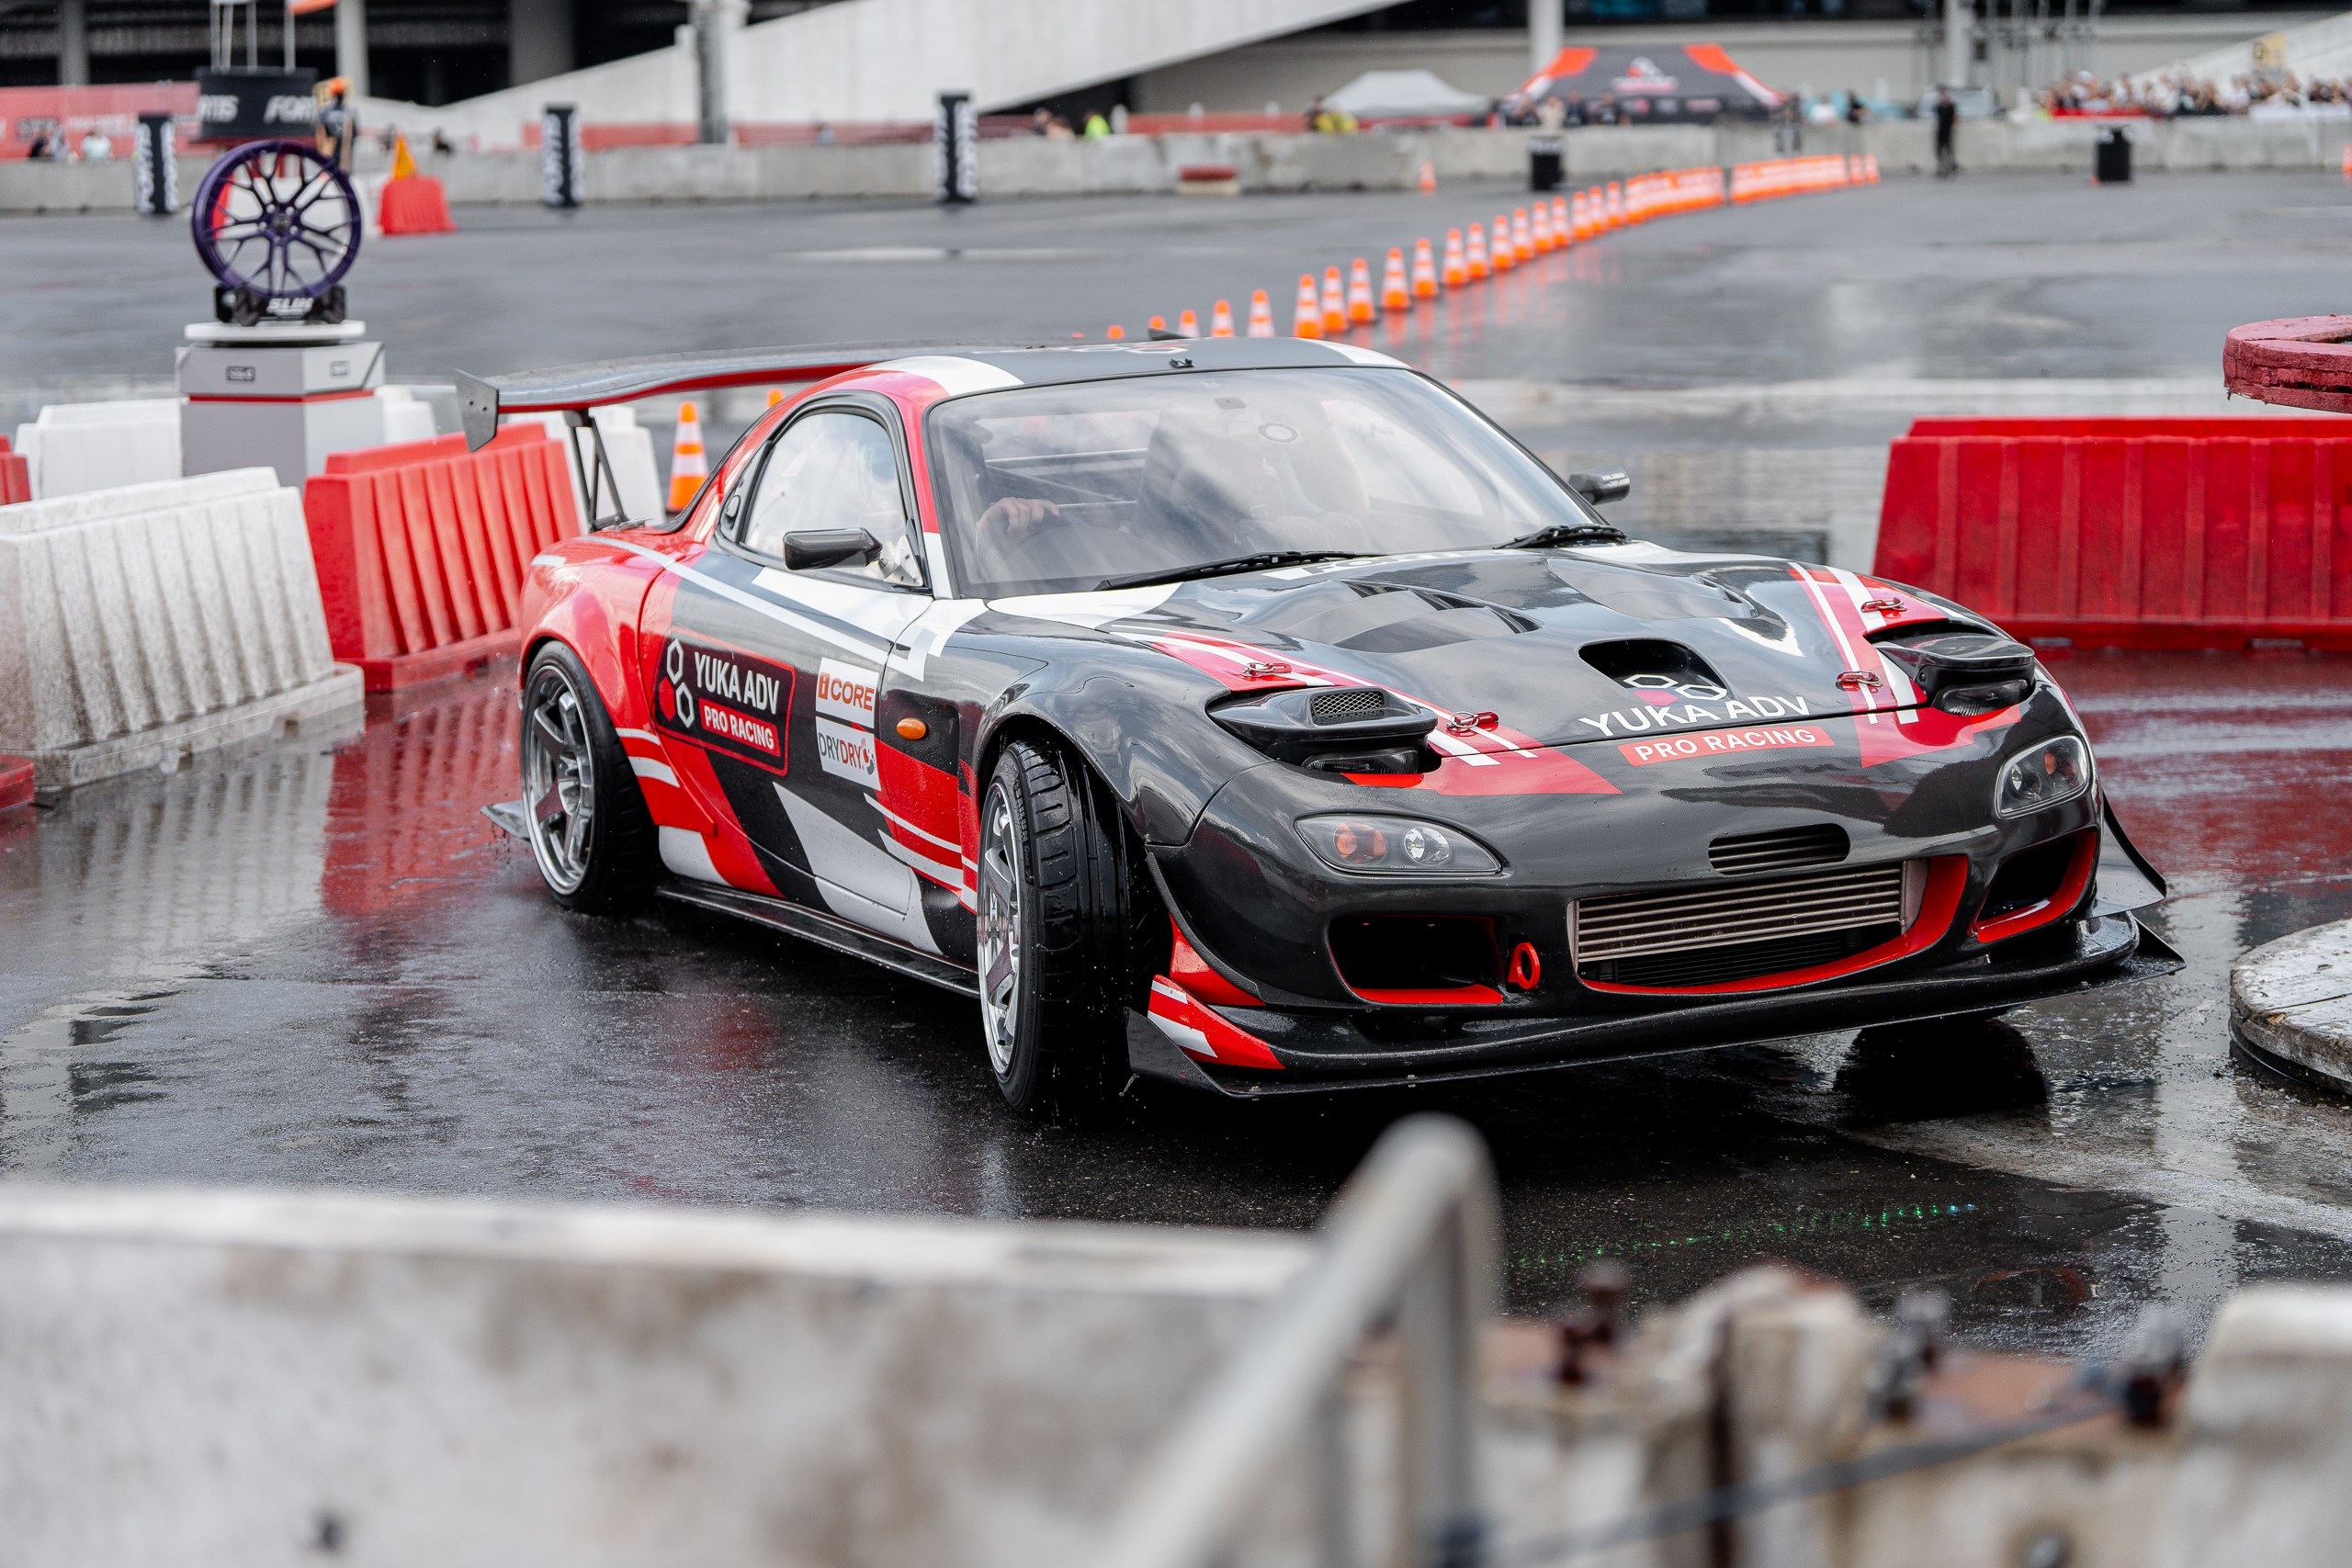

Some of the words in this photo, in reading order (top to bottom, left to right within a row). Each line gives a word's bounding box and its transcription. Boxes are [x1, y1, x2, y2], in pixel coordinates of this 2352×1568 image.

[695, 651, 741, 703] YUKA
[743, 669, 780, 715] ADV
[703, 705, 729, 732] PRO
[729, 714, 775, 750] RACING
[1578, 704, 1721, 737] YUKA
[1725, 695, 1811, 719] ADV
[1634, 738, 1699, 761] PRO
[1702, 728, 1816, 750] RACING
